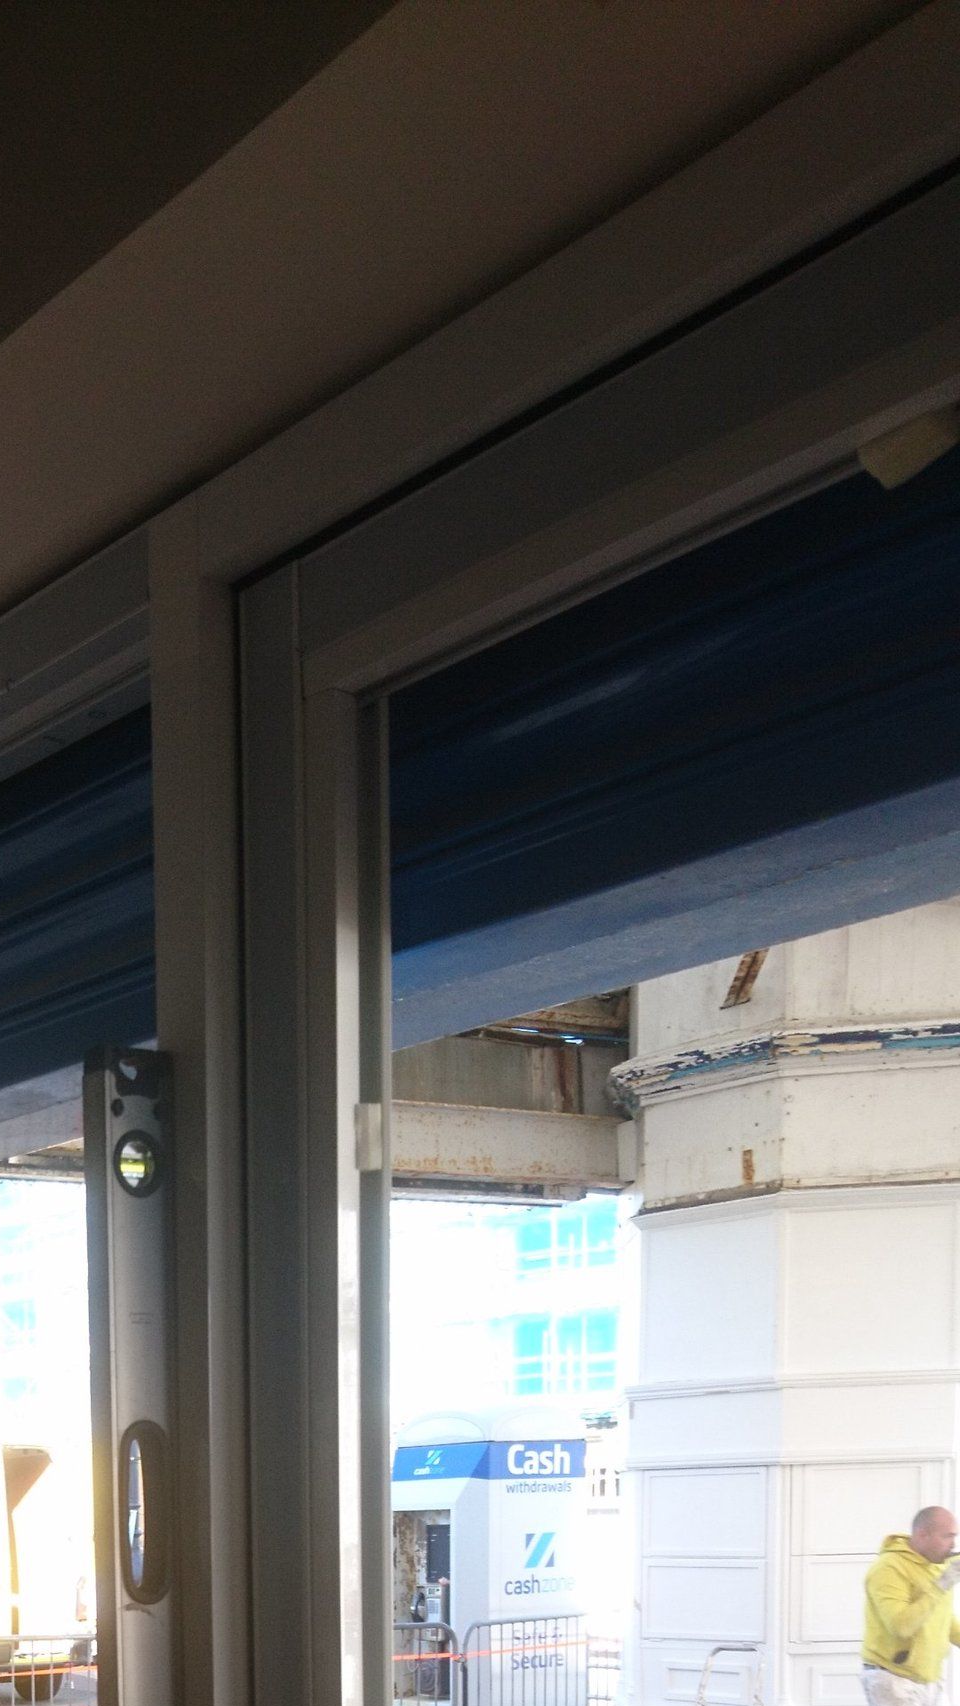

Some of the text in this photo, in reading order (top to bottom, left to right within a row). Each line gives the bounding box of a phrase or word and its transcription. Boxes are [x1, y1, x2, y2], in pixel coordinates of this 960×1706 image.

[507, 1444, 571, 1475] Cash
[506, 1480, 572, 1494] withdrawals
[511, 1652, 565, 1671] Secure
